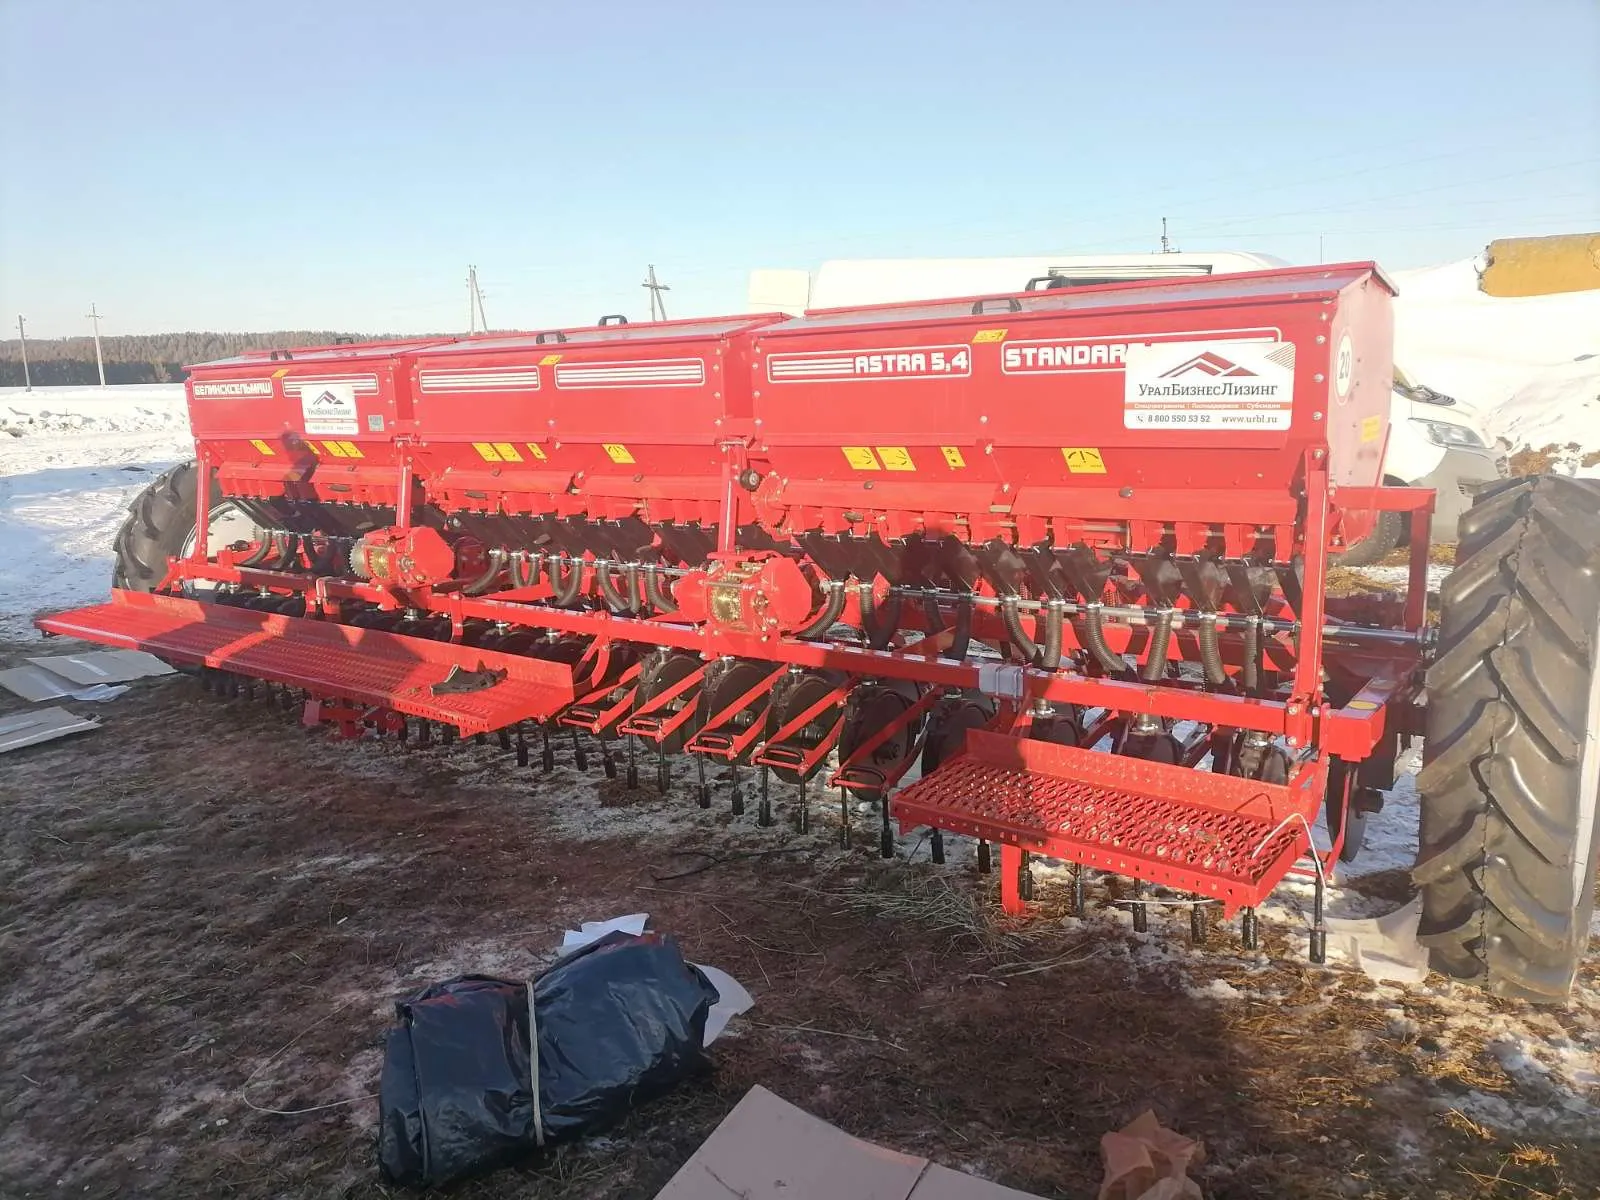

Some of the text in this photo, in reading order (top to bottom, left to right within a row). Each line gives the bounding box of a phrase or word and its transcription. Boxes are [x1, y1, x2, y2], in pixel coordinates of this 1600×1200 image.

[855, 353, 926, 373] ASTRA
[1005, 343, 1145, 368] STANDAR
[1339, 351, 1351, 379] 20
